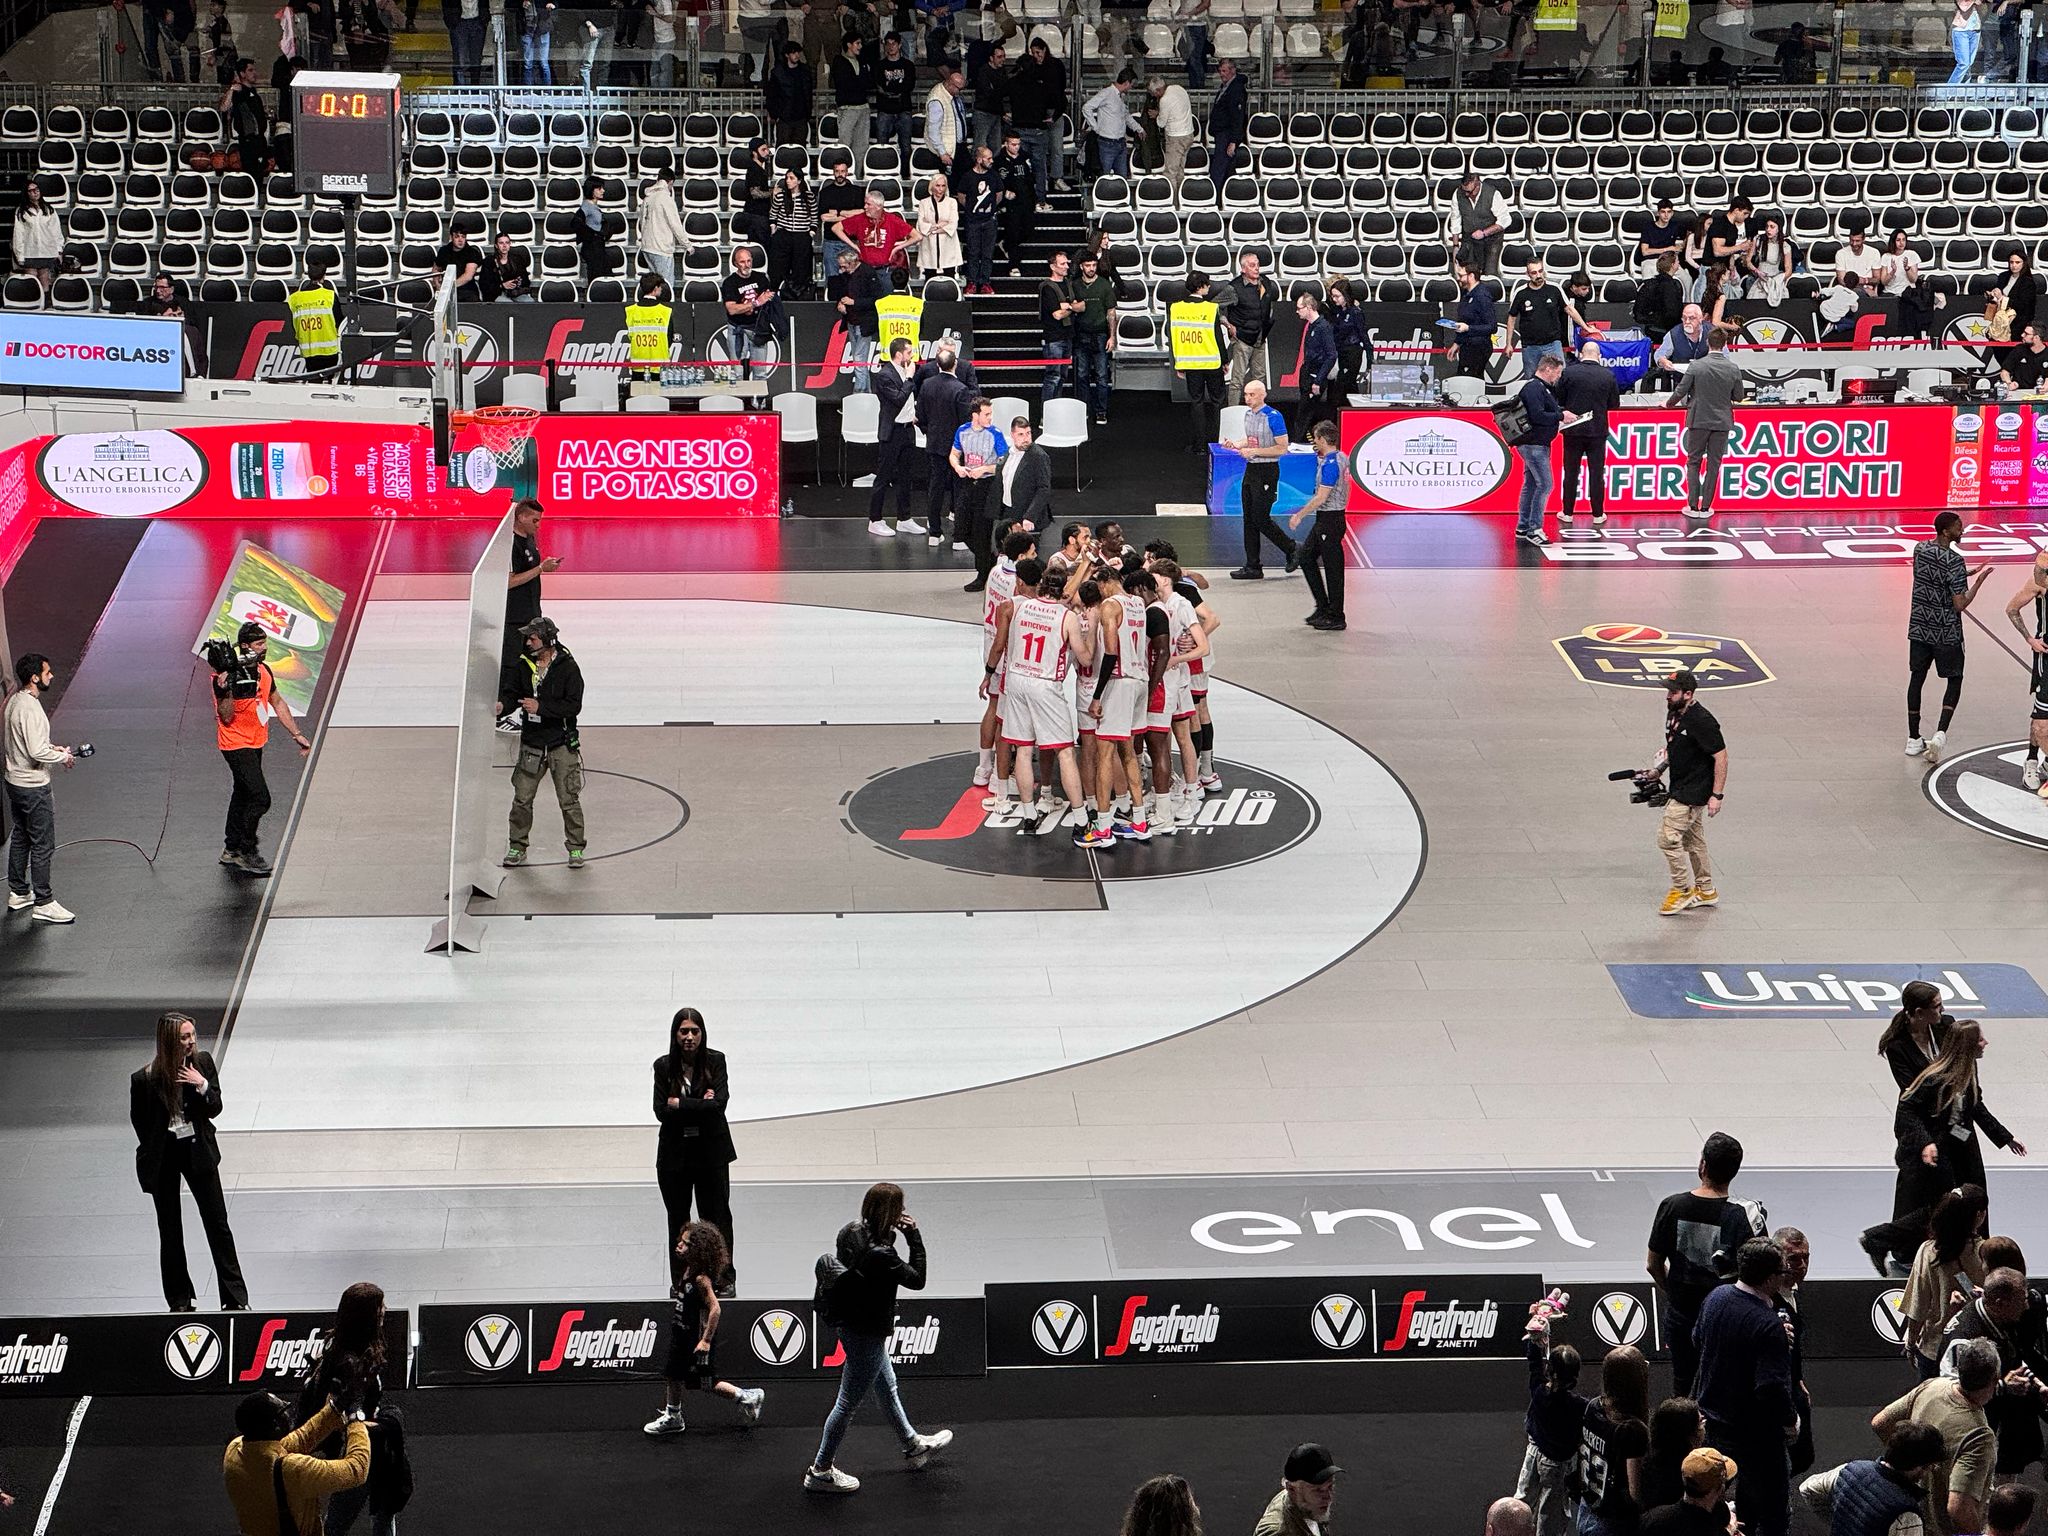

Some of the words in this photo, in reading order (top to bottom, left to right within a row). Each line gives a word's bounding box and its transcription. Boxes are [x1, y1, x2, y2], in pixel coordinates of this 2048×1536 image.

[301, 316, 323, 331] 0428
[889, 321, 911, 336] 0463
[635, 333, 658, 348] 0326
[1180, 330, 1203, 344] 0406
[24, 342, 171, 364] DOCTORGLASS
[1583, 420, 1889, 459] NTERATORI
[557, 438, 753, 468] MAGNESIO
[1954, 446, 1978, 455] Difesa
[1993, 444, 2021, 453] Ricarica
[272, 448, 285, 471] ZERO
[1365, 459, 1498, 476] L'ANGELICA
[52, 465, 196, 483] L'ANGELICA
[383, 442, 398, 498] POTASSIO
[65, 486, 112, 494] ISTITUTO
[115, 486, 182, 494] ERBORISTICO
[553, 472, 572, 499] E
[583, 470, 758, 499] POTASSIO
[1375, 479, 1419, 487] ISTITUTO
[1422, 479, 1484, 487] ERBORISTICO
[1558, 524, 1937, 539] SEGAFREDO
[1540, 535, 2048, 561] BOLOG
[1022, 632, 1046, 663] 11
[1594, 658, 1747, 673] LBA
[1190, 1193, 1596, 1255] enel
[1104, 1296, 1220, 1356] Segafredo
[1383, 1290, 1498, 1350] Segafredo
[538, 1310, 658, 1372] Segafredo
[1157, 1344, 1198, 1353] ZANETTI
[1436, 1340, 1477, 1348] ZANETTI
[0, 1333, 67, 1374] afredo
[592, 1359, 634, 1368] ZANETTI
[1, 1374, 44, 1384] ZANETTI
